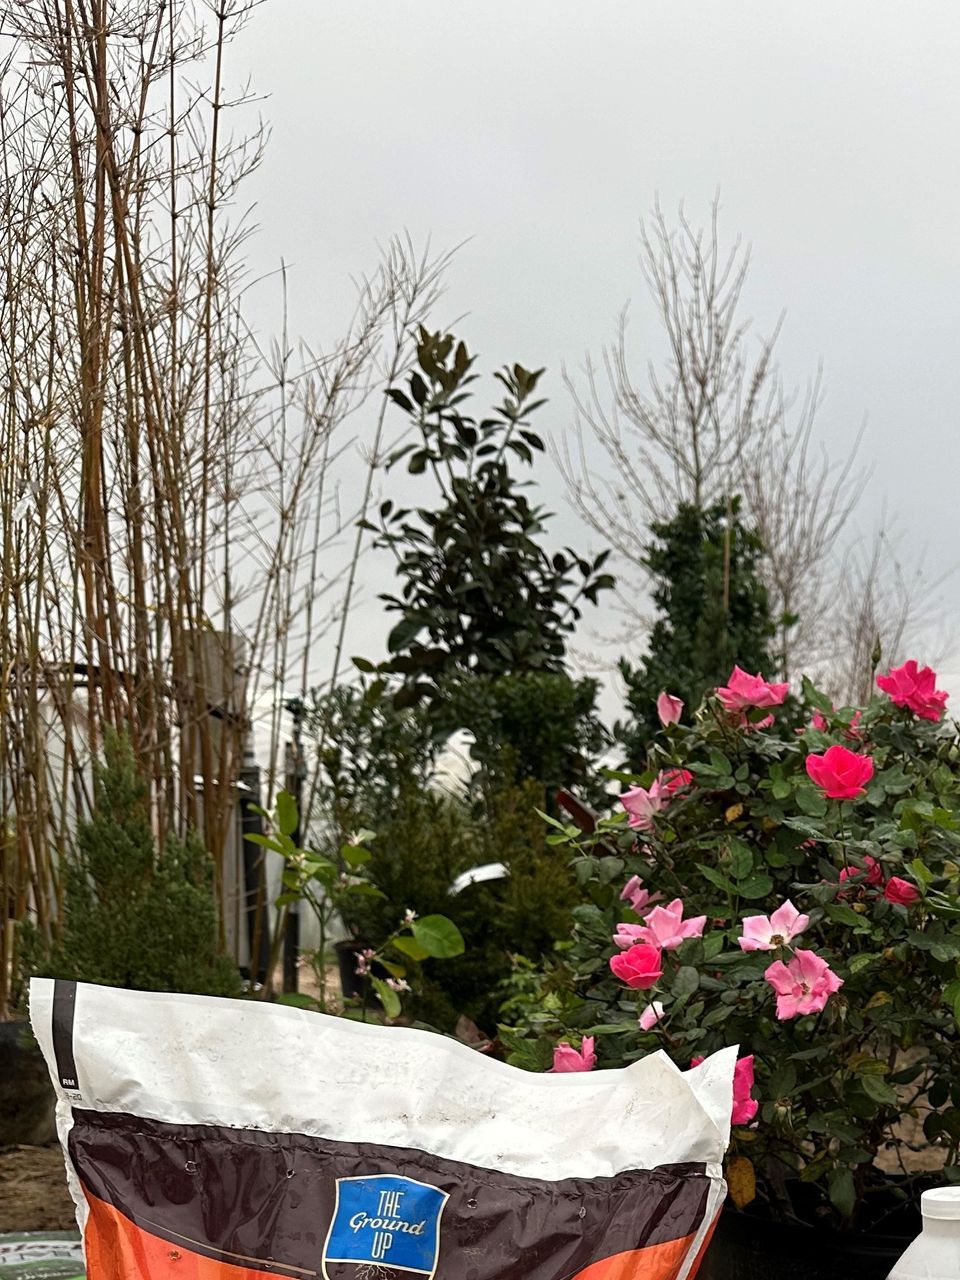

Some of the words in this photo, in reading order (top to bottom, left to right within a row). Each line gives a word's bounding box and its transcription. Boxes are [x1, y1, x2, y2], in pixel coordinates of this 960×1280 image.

[62, 1078, 75, 1086] RM
[377, 1190, 405, 1219] THE
[349, 1212, 427, 1236] Ground
[371, 1232, 393, 1259] UP
